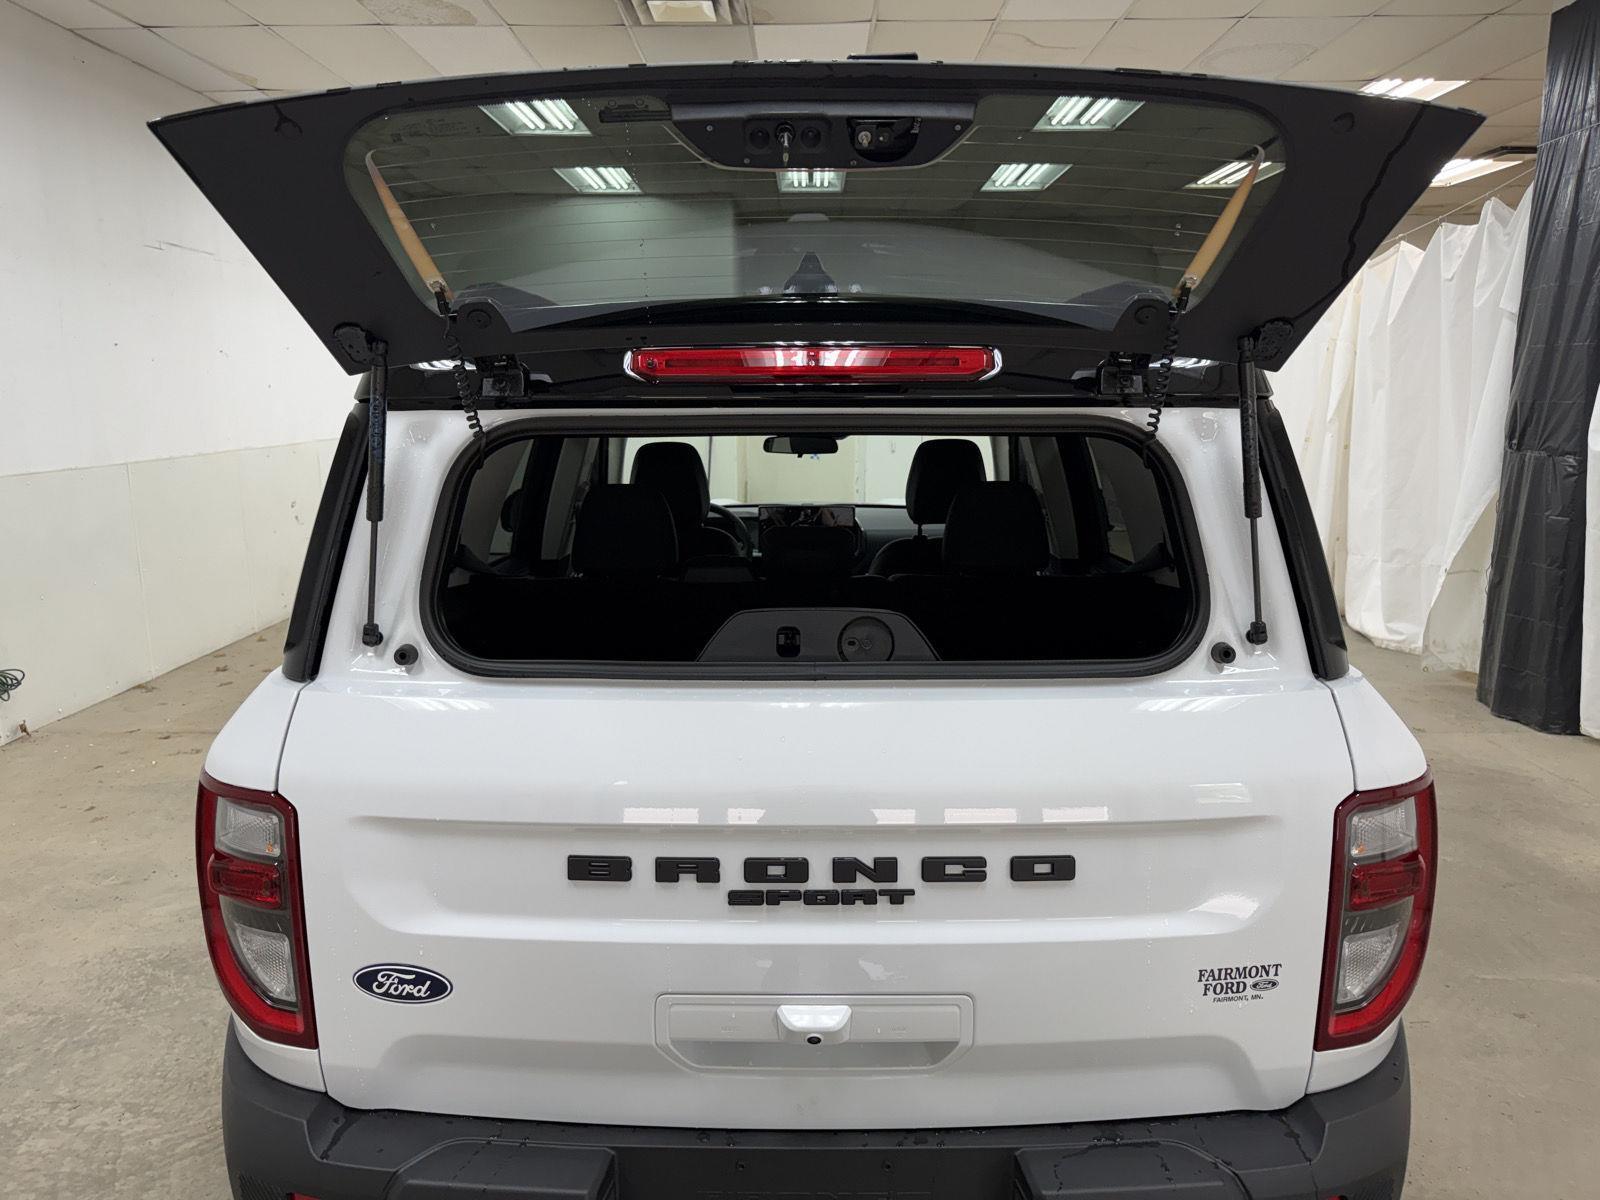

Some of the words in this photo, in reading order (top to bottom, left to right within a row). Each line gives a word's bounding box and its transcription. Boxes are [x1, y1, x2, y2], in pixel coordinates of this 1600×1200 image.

[567, 854, 1076, 883] BRONCO
[727, 889, 916, 906] SPORT
[1197, 963, 1282, 982] FAIRMONT
[372, 970, 432, 998] Ford
[1203, 980, 1247, 996] FORD
[1213, 994, 1249, 1003] FAIRMONT,
